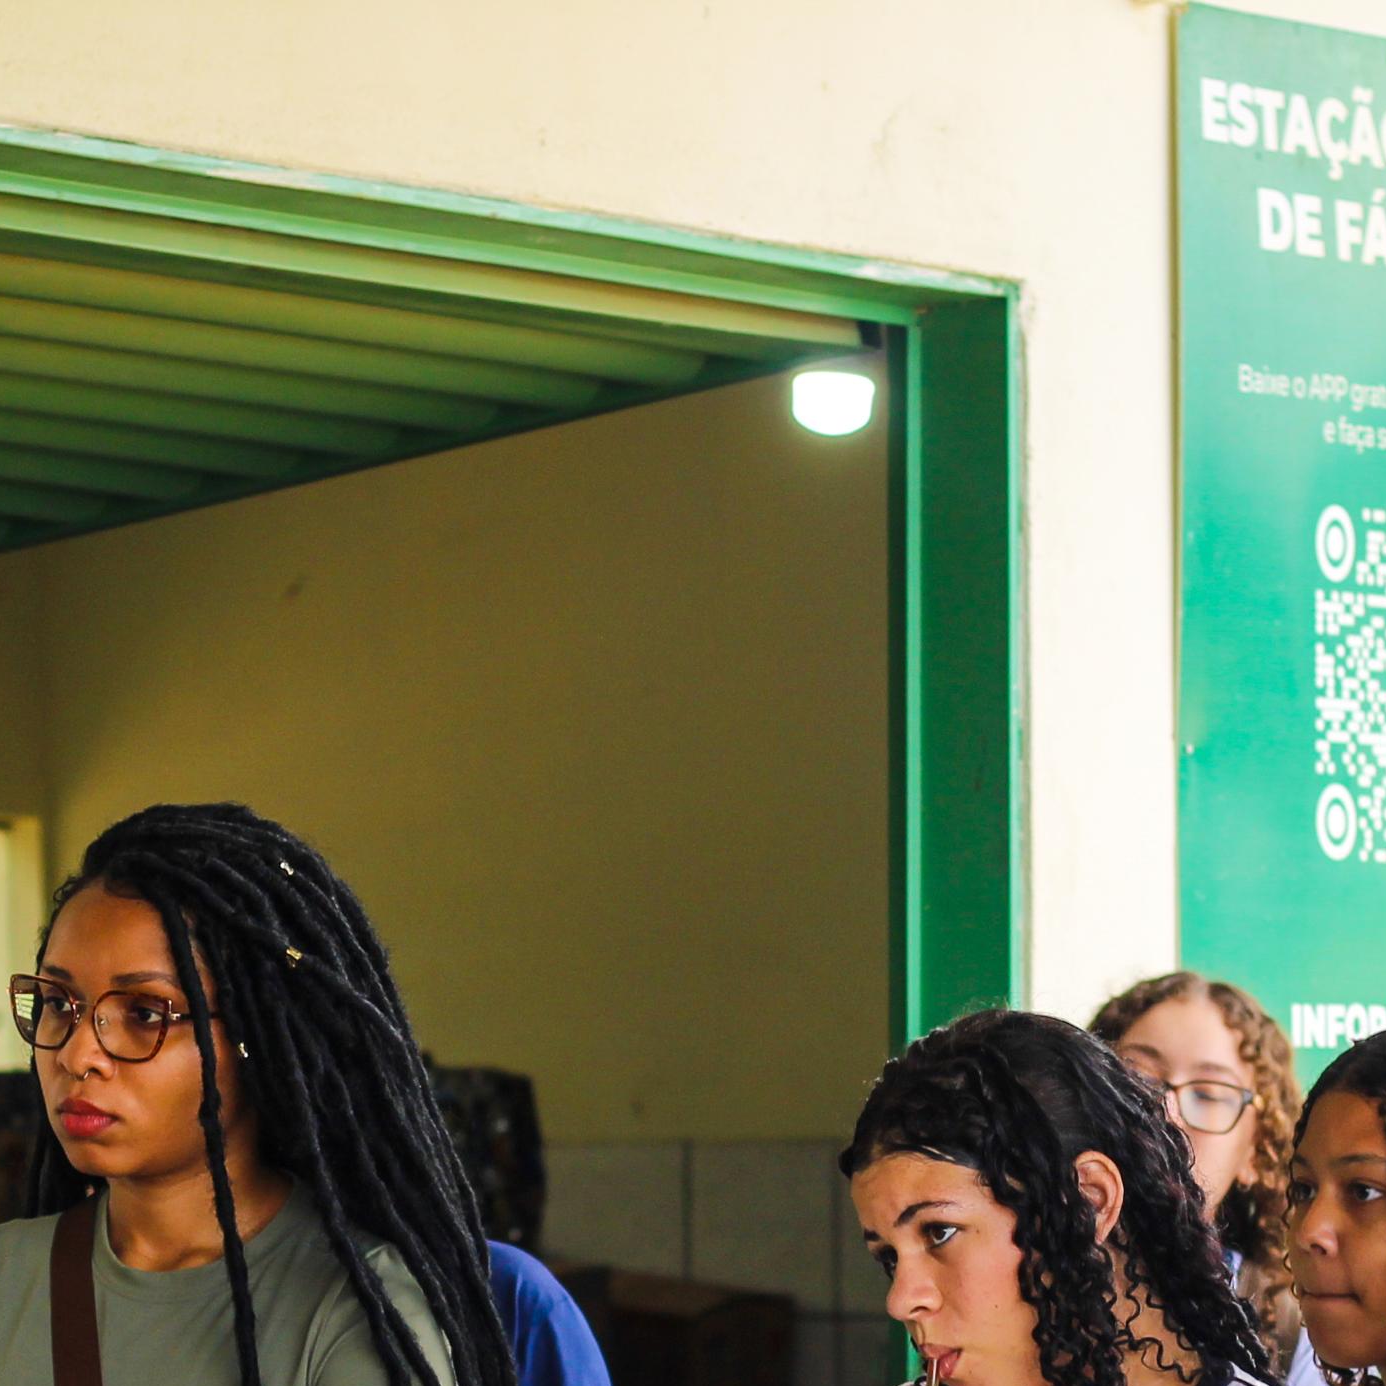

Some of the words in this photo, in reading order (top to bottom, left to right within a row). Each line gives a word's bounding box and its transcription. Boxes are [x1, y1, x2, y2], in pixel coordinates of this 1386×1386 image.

[1257, 187, 1326, 258] DE
[1238, 363, 1290, 397] Baixe
[1293, 376, 1307, 399] o
[1308, 373, 1348, 402] APP
[1323, 420, 1337, 444] e
